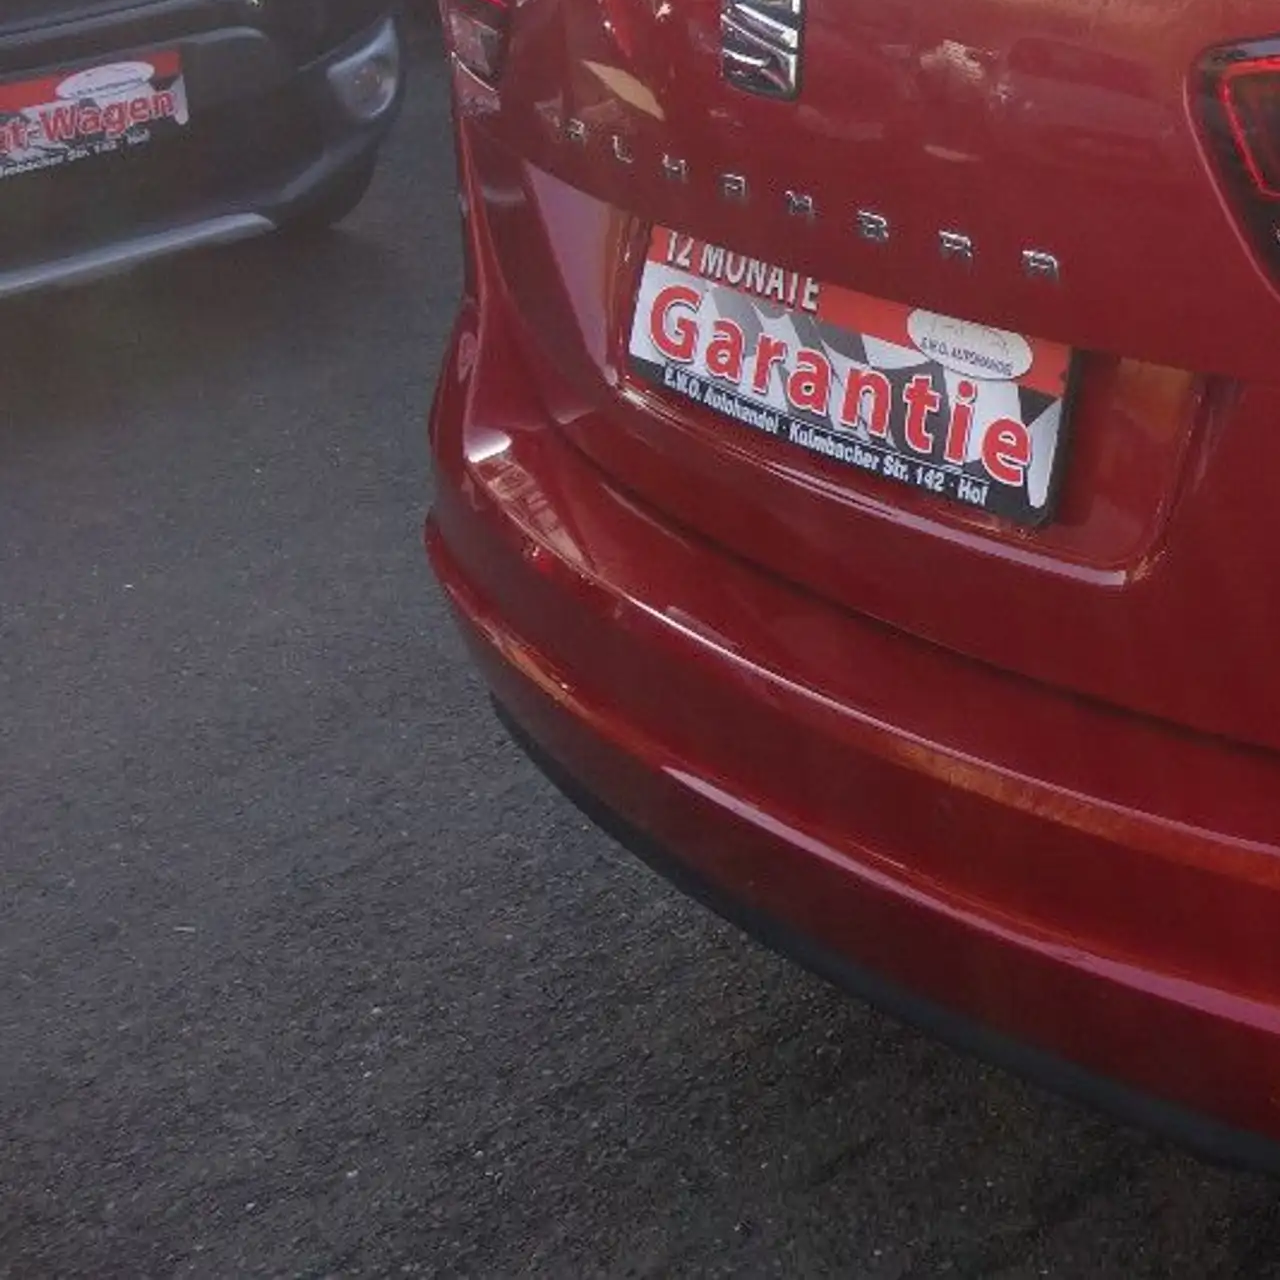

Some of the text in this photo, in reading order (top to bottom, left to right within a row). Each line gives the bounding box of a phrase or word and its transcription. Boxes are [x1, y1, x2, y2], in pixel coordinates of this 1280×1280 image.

[667, 231, 695, 268] 12
[648, 283, 1032, 487] Garantie
[702, 381, 780, 434] Autohandel
[788, 420, 880, 471] Kulmbacher
[882, 454, 909, 482] Str.
[914, 466, 946, 493] 142
[956, 476, 989, 506] Hof
